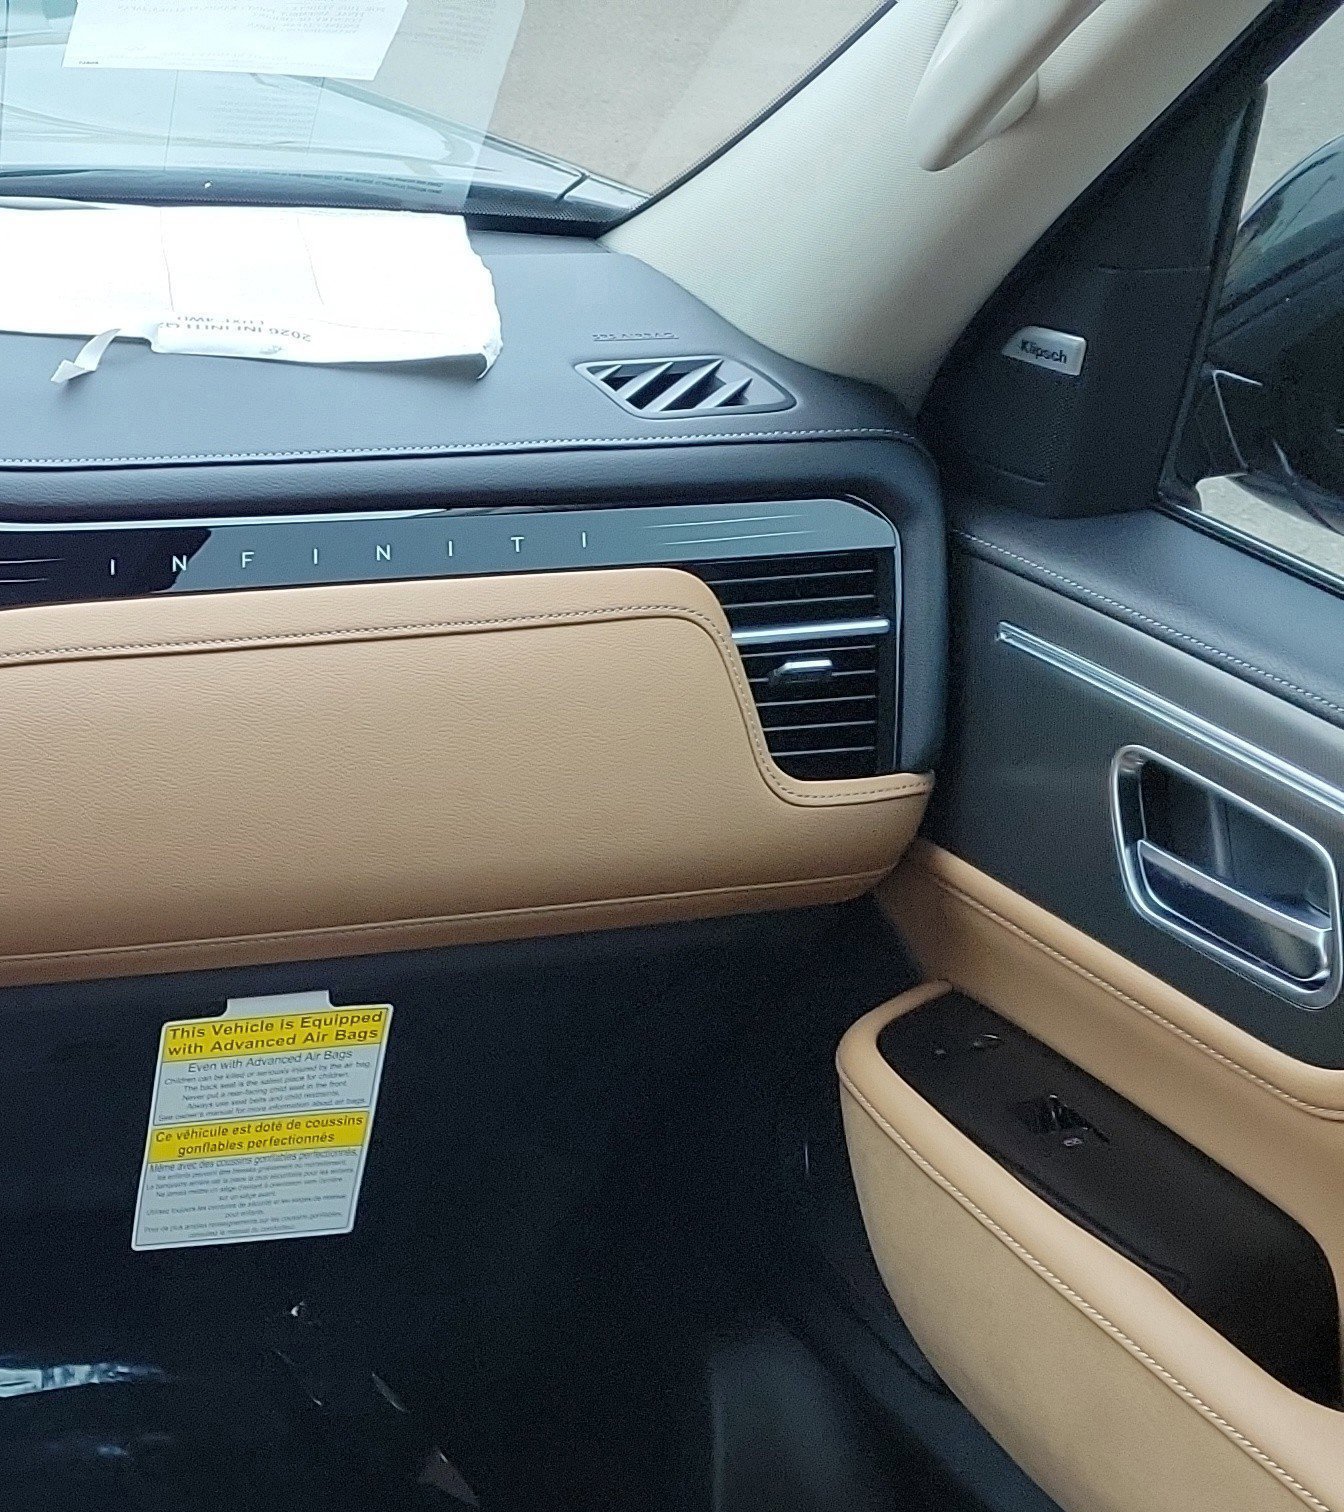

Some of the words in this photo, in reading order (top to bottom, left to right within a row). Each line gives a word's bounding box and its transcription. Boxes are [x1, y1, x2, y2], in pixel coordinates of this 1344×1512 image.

[1020, 339, 1068, 364] Klipsch
[110, 532, 588, 576] INFINITI
[168, 1026, 205, 1040] This
[210, 1019, 274, 1036] Vehicle
[279, 1017, 295, 1030] is
[299, 1010, 383, 1030] Equipped
[167, 1042, 203, 1055] with
[210, 1033, 296, 1051] Advanced
[302, 1030, 329, 1043] Air
[334, 1026, 379, 1043] Bags
[187, 1060, 217, 1072] Even
[220, 1058, 242, 1069] with
[245, 1052, 301, 1066] Advanced
[304, 1051, 321, 1061] Air
[323, 1048, 353, 1061] Bags
[155, 1131, 172, 1142] Ce
[176, 1125, 228, 1140] véhicule
[232, 1124, 251, 1135] est
[254, 1120, 282, 1133] doté
[286, 1118, 301, 1130] de
[304, 1113, 363, 1129] coussins
[177, 1139, 243, 1157] gonflables
[247, 1131, 335, 1150] perfectionnés
